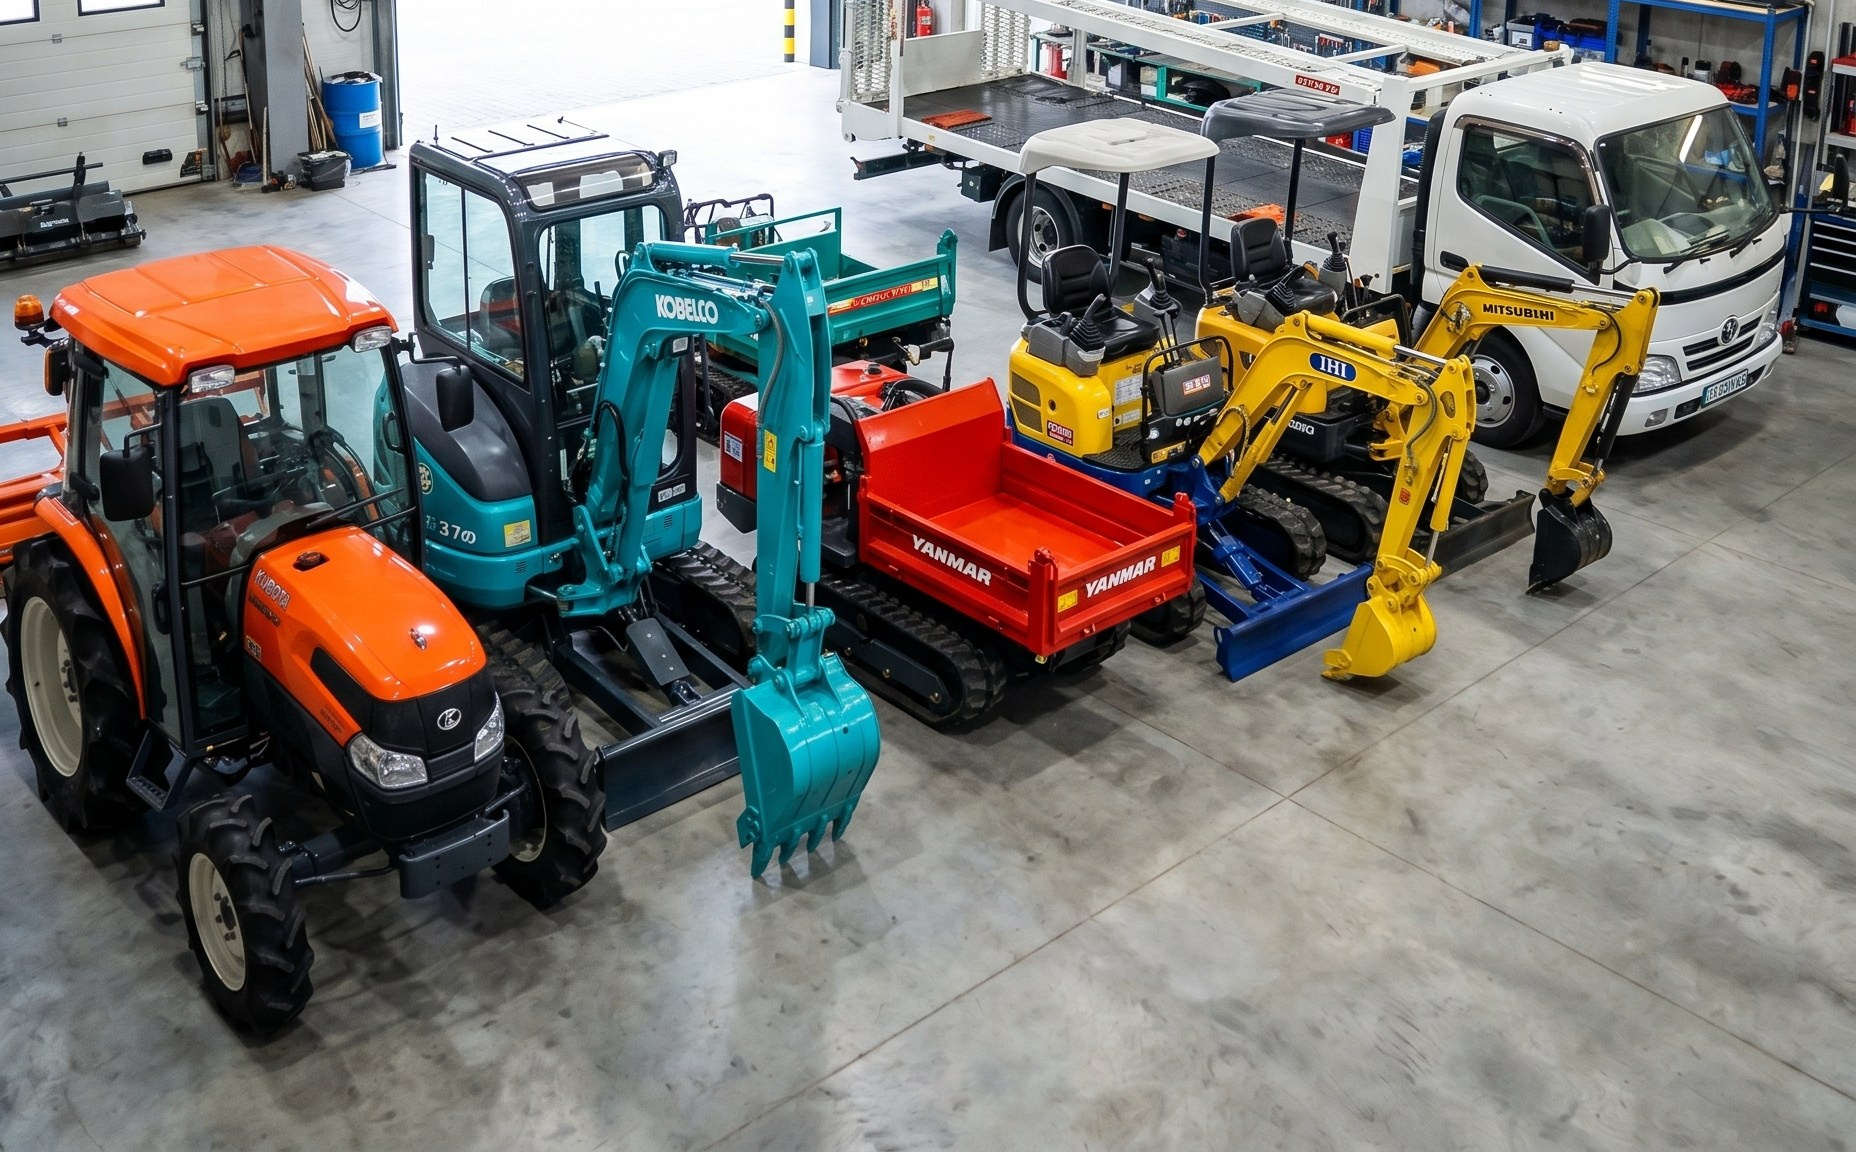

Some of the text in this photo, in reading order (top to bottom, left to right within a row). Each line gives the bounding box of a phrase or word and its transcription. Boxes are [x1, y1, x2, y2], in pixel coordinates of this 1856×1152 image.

[655, 294, 719, 325] KOBELCO
[1320, 355, 1347, 378] IHI
[912, 534, 992, 586] YANMAR
[1085, 555, 1157, 598] YANMAR
[255, 568, 291, 611] KUBOTA
